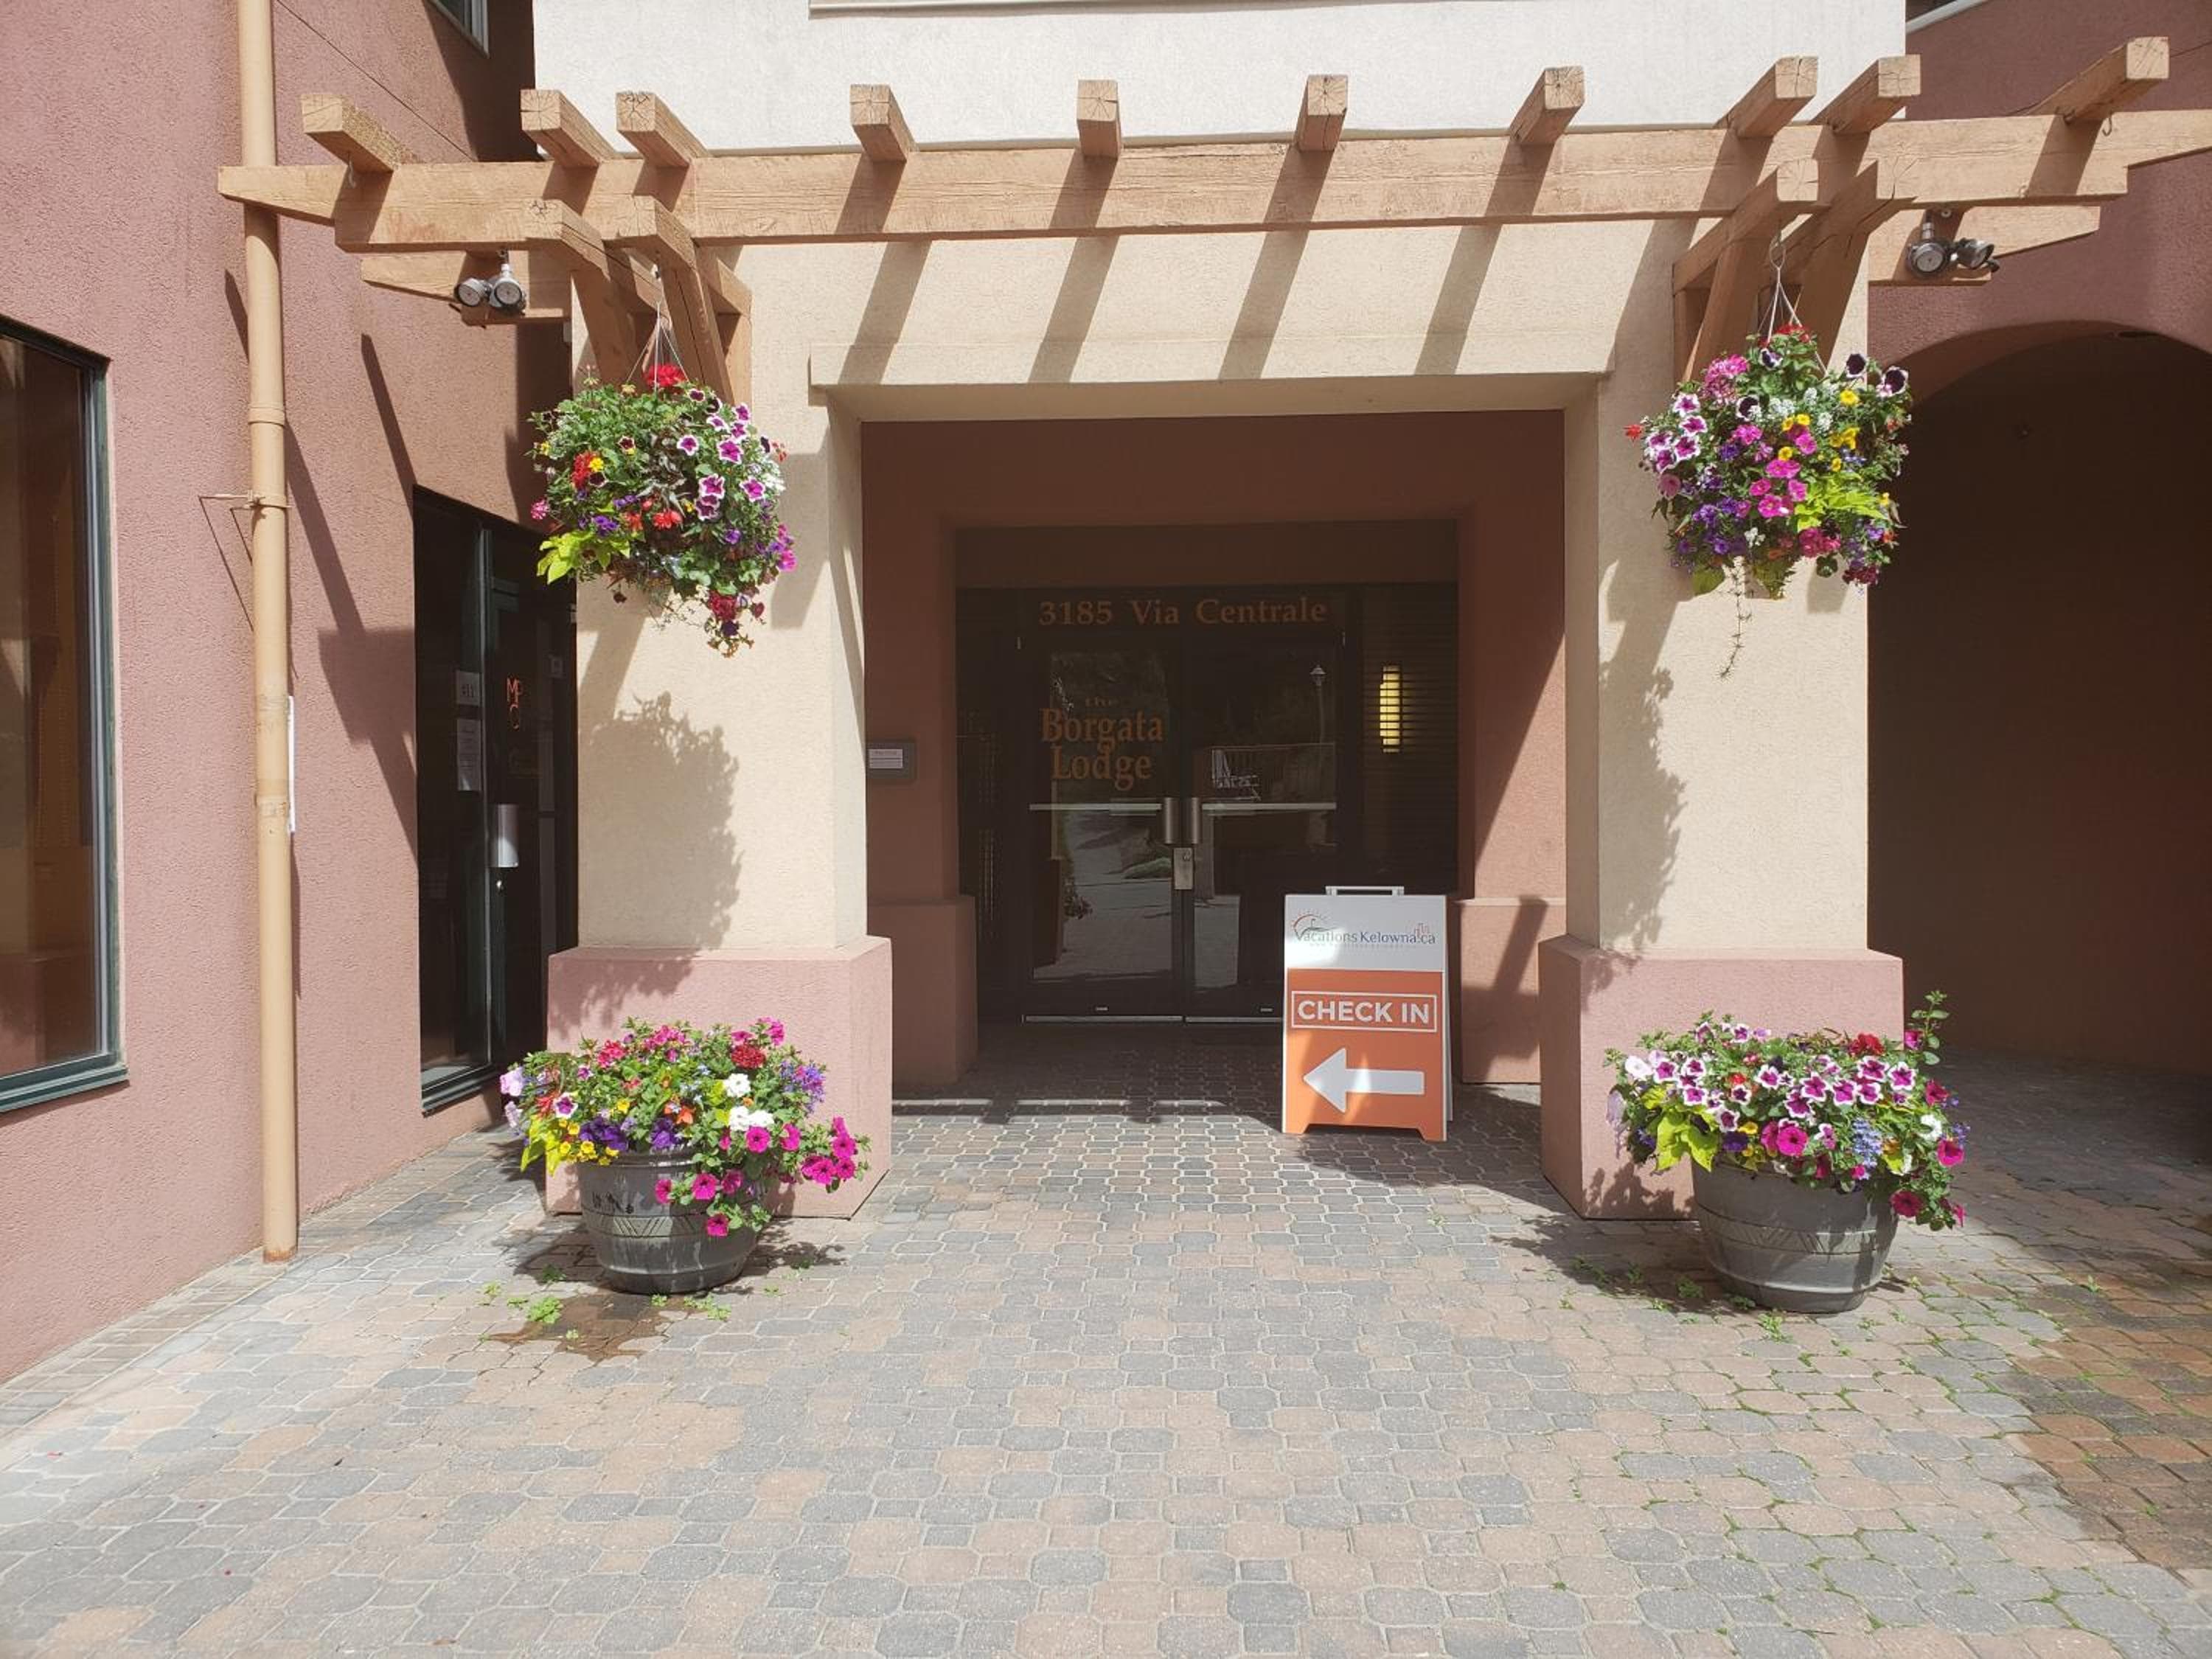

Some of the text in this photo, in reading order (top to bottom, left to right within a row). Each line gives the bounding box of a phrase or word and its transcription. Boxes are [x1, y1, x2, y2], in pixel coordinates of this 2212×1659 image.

[1039, 597, 1326, 625] 3185 Via Centrale
[1040, 709, 1163, 752] Borgata
[1053, 747, 1151, 790] Lodge
[1298, 1000, 1430, 1024] CHECK IN
